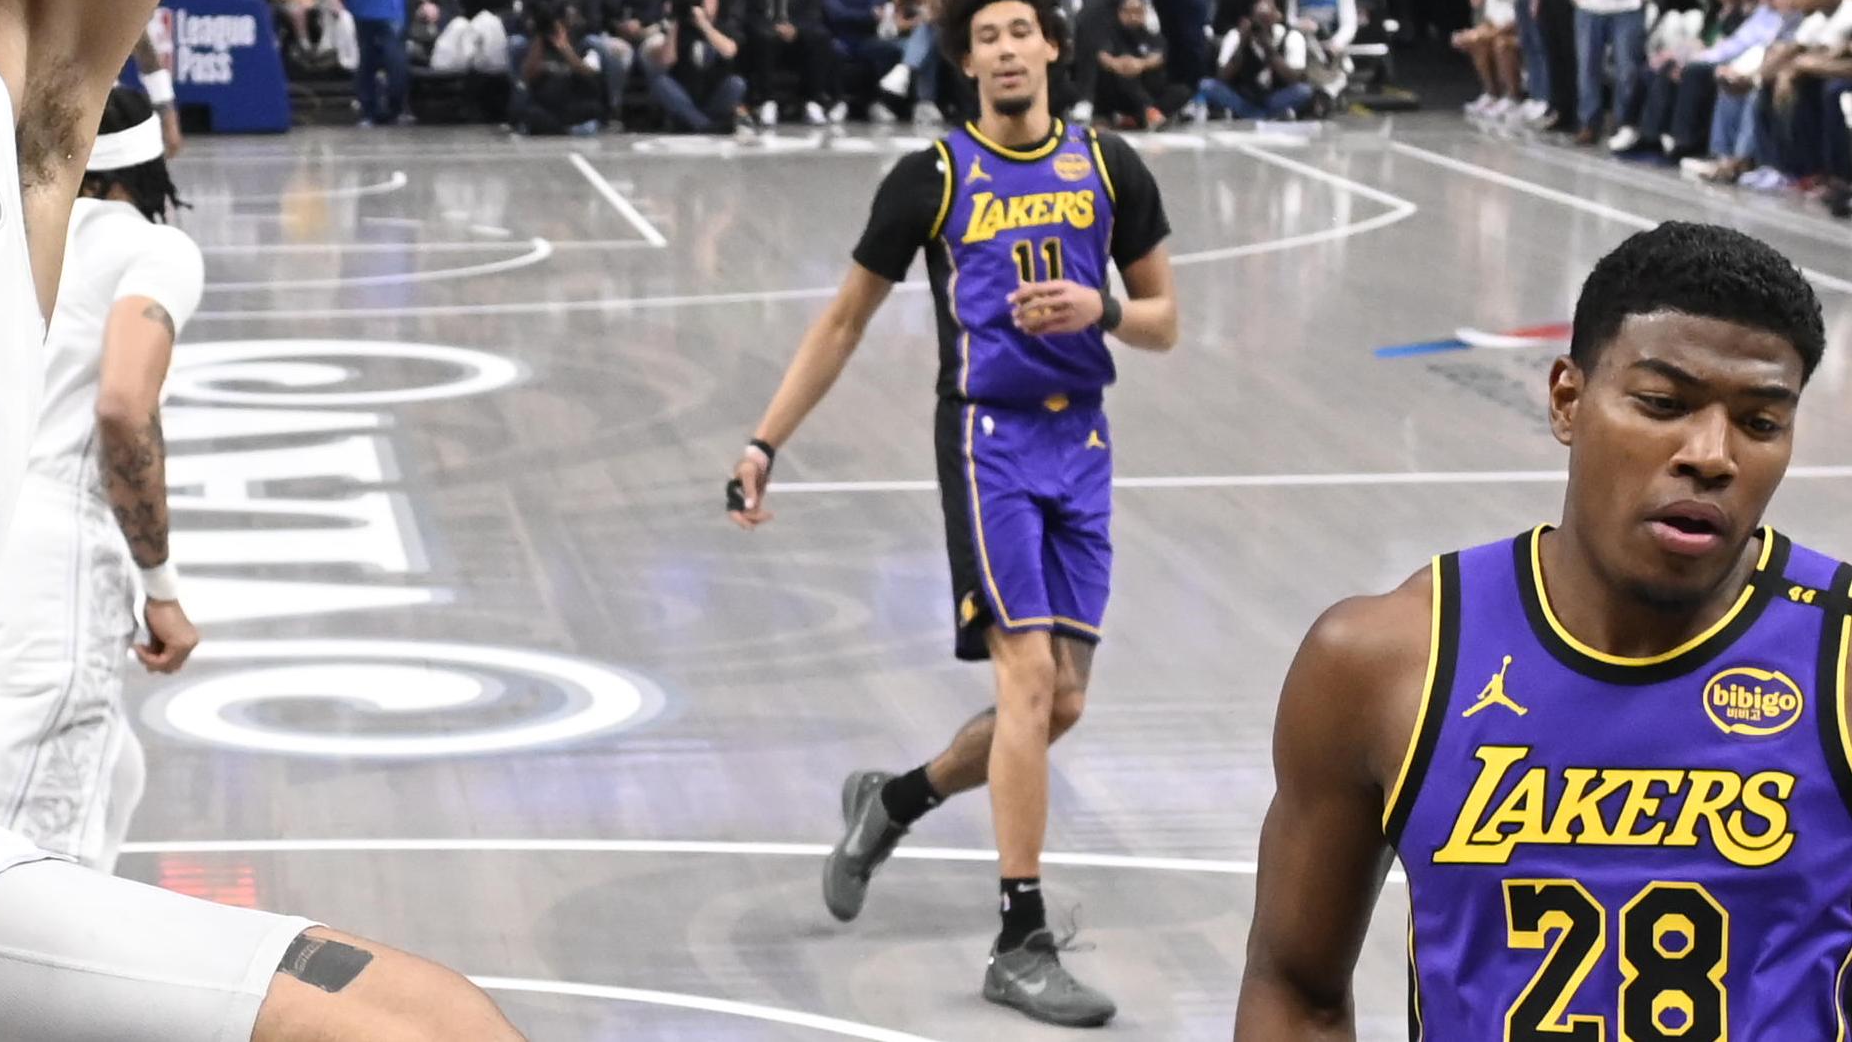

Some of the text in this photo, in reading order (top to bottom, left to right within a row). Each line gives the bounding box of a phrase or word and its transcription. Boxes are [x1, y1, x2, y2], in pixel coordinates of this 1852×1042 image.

[177, 9, 257, 51] League
[177, 44, 233, 84] Pass
[961, 190, 1096, 245] LAKERS
[1012, 237, 1065, 286] 11
[1712, 683, 1797, 718] bibigo
[1432, 745, 1796, 867] LAKERS
[1501, 878, 1730, 1042] 28
